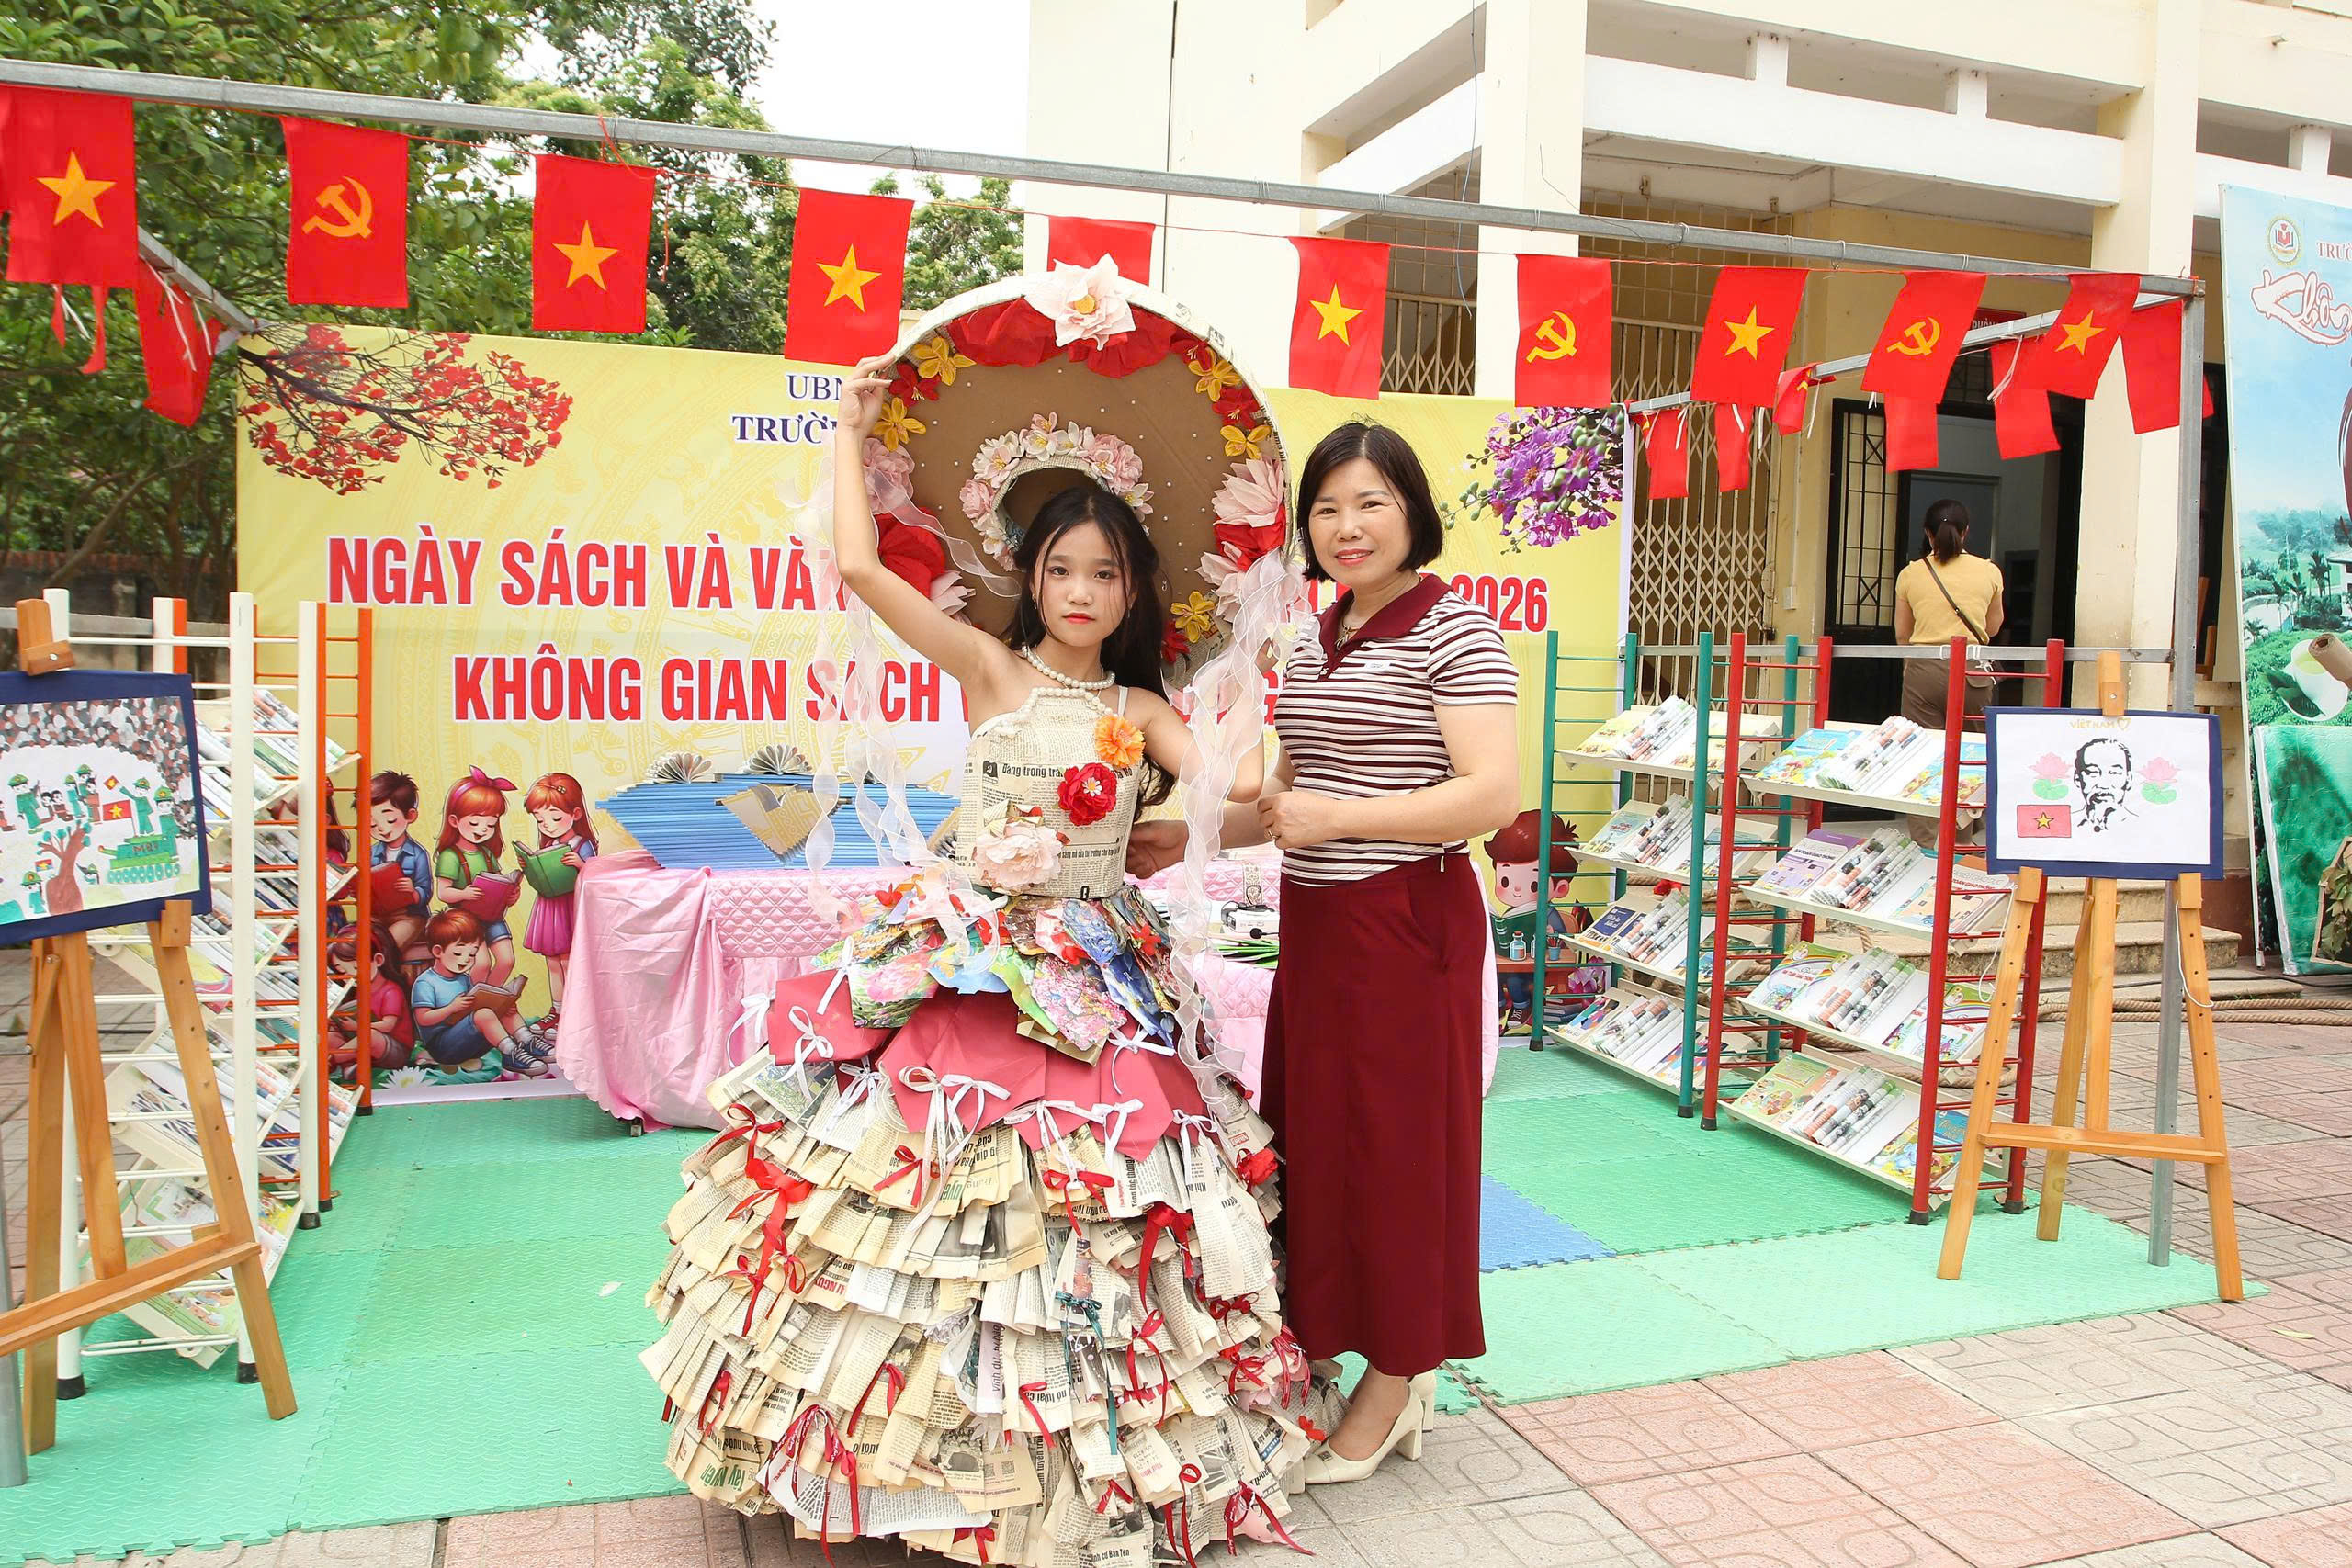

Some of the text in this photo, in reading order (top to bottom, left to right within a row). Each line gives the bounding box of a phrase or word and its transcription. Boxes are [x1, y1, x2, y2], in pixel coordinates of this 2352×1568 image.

[732, 412, 838, 444] TRƯỜ
[328, 525, 481, 604] NGÀY
[502, 528, 646, 607] SÁCH
[666, 533, 732, 609] VÀ
[455, 644, 641, 721] KHÔNG
[662, 658, 786, 721] GIAN
